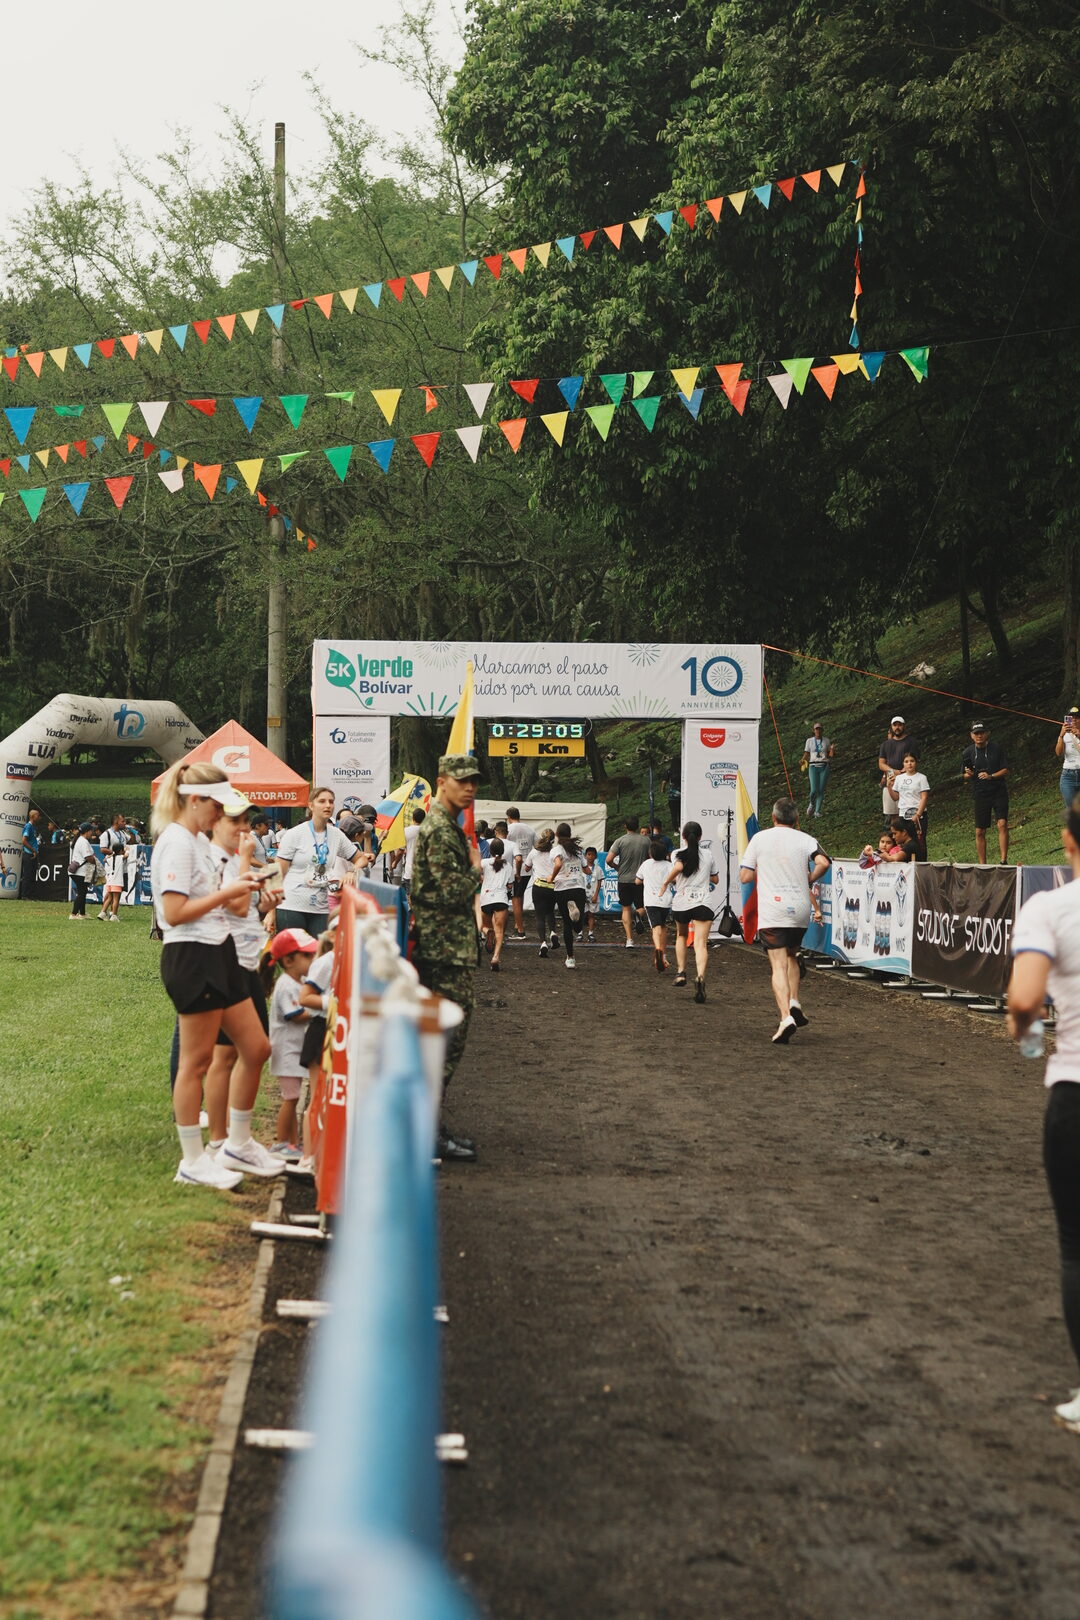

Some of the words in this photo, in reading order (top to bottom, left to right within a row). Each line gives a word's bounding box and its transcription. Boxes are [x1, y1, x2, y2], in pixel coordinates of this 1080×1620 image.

[327, 662, 351, 677] 5K
[357, 653, 413, 678] Verde
[473, 654, 552, 675] Marcamos
[556, 656, 569, 675] el
[572, 662, 608, 682] paso
[681, 656, 743, 697] 10
[360, 680, 413, 694] Bolívar
[511, 684, 537, 702] por
[542, 684, 572, 696] una
[576, 684, 620, 696] causa
[46, 728, 74, 740] Yodora
[492, 723, 583, 738] 0:29:09
[28, 744, 56, 759] LUA
[509, 742, 518, 754] 5
[538, 743, 569, 754] Km
[332, 767, 371, 777] Kingspan
[917, 908, 950, 948] STUDIO
[950, 914, 960, 948] F
[964, 915, 1002, 956] STUDIO
[1004, 918, 1013, 956] F
